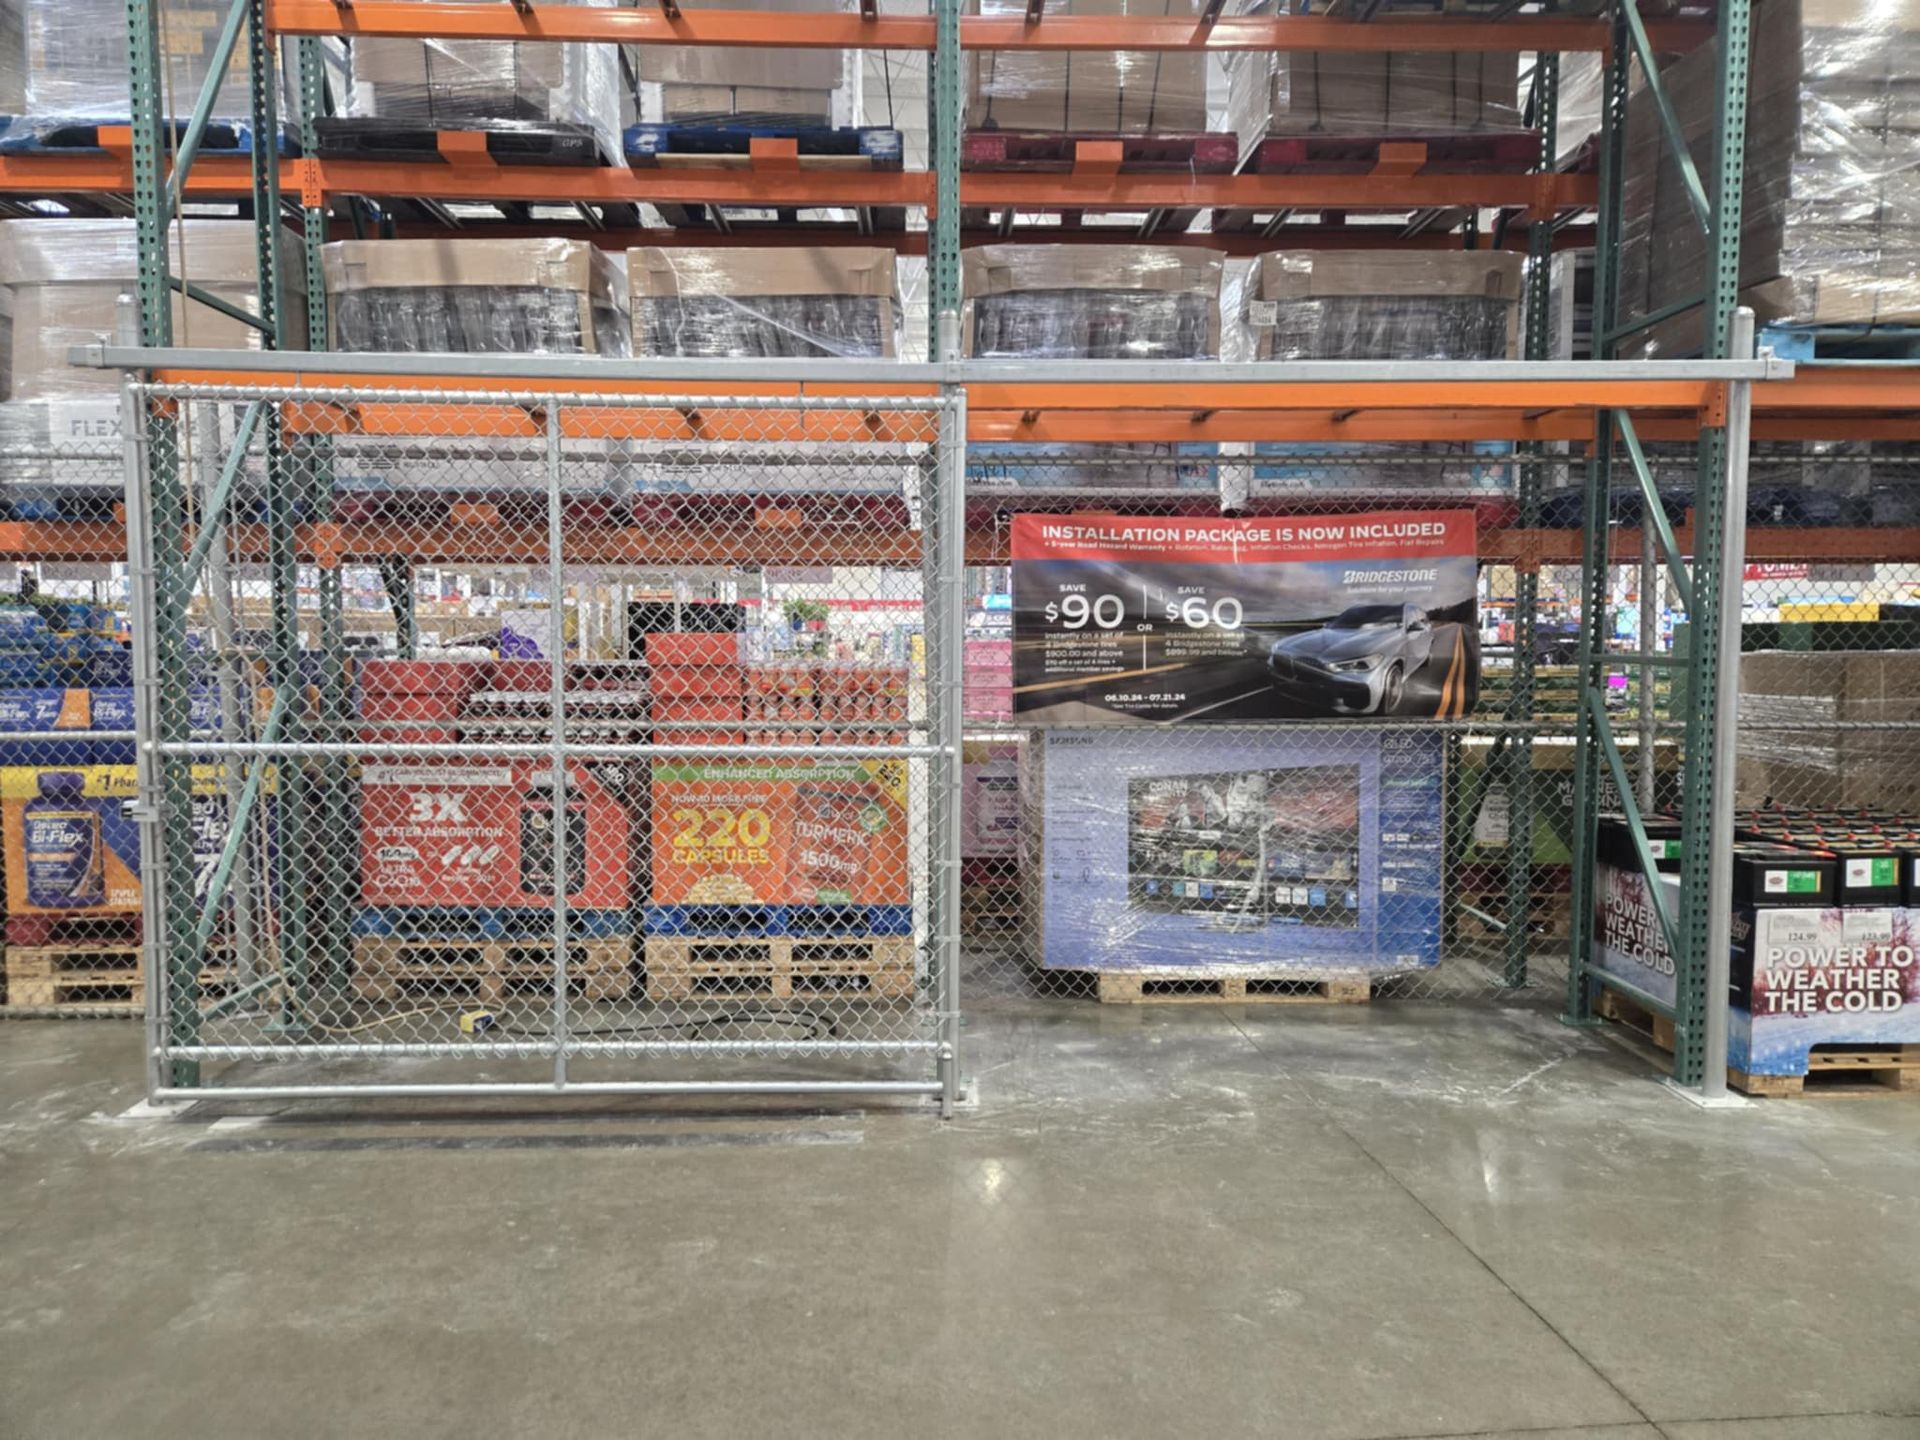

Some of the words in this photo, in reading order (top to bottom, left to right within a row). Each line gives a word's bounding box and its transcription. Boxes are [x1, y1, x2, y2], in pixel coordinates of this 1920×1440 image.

[1042, 525, 1180, 542] INSTALLATION
[1185, 528, 1272, 543] PACKAGE
[1276, 528, 1294, 541] IS
[1298, 526, 1345, 540] NOW
[1350, 522, 1447, 538] INCLUDED
[1077, 541, 1098, 549] Road
[1099, 542, 1128, 550] Hazard
[1129, 543, 1166, 552] Warranty
[1342, 568, 1439, 584] BRIDGESTONE
[1060, 584, 1087, 592] SAVE
[1177, 586, 1206, 594] SAVE
[1045, 593, 1125, 630] $90
[1165, 596, 1243, 630] $60
[1137, 623, 1153, 632] OR
[704, 768, 773, 779] ENHANCED
[775, 768, 855, 779] ABSORPTION
[409, 793, 467, 822] 3X
[32, 830, 84, 847] Bi-Flex
[672, 809, 771, 847] 220
[795, 821, 871, 847] TURMERIC
[672, 848, 769, 864] CAPSULES
[1605, 893, 1656, 927] POWER
[1788, 932, 1818, 941] 124.99
[1605, 929, 1630, 956] THE
[1633, 943, 1676, 975] COLD
[1767, 946, 1868, 968] POWER
[1876, 945, 1914, 967] TO
[1766, 968, 1900, 990] WEATHER
[1765, 991, 1817, 1013] THE
[1825, 990, 1903, 1013] COLD
